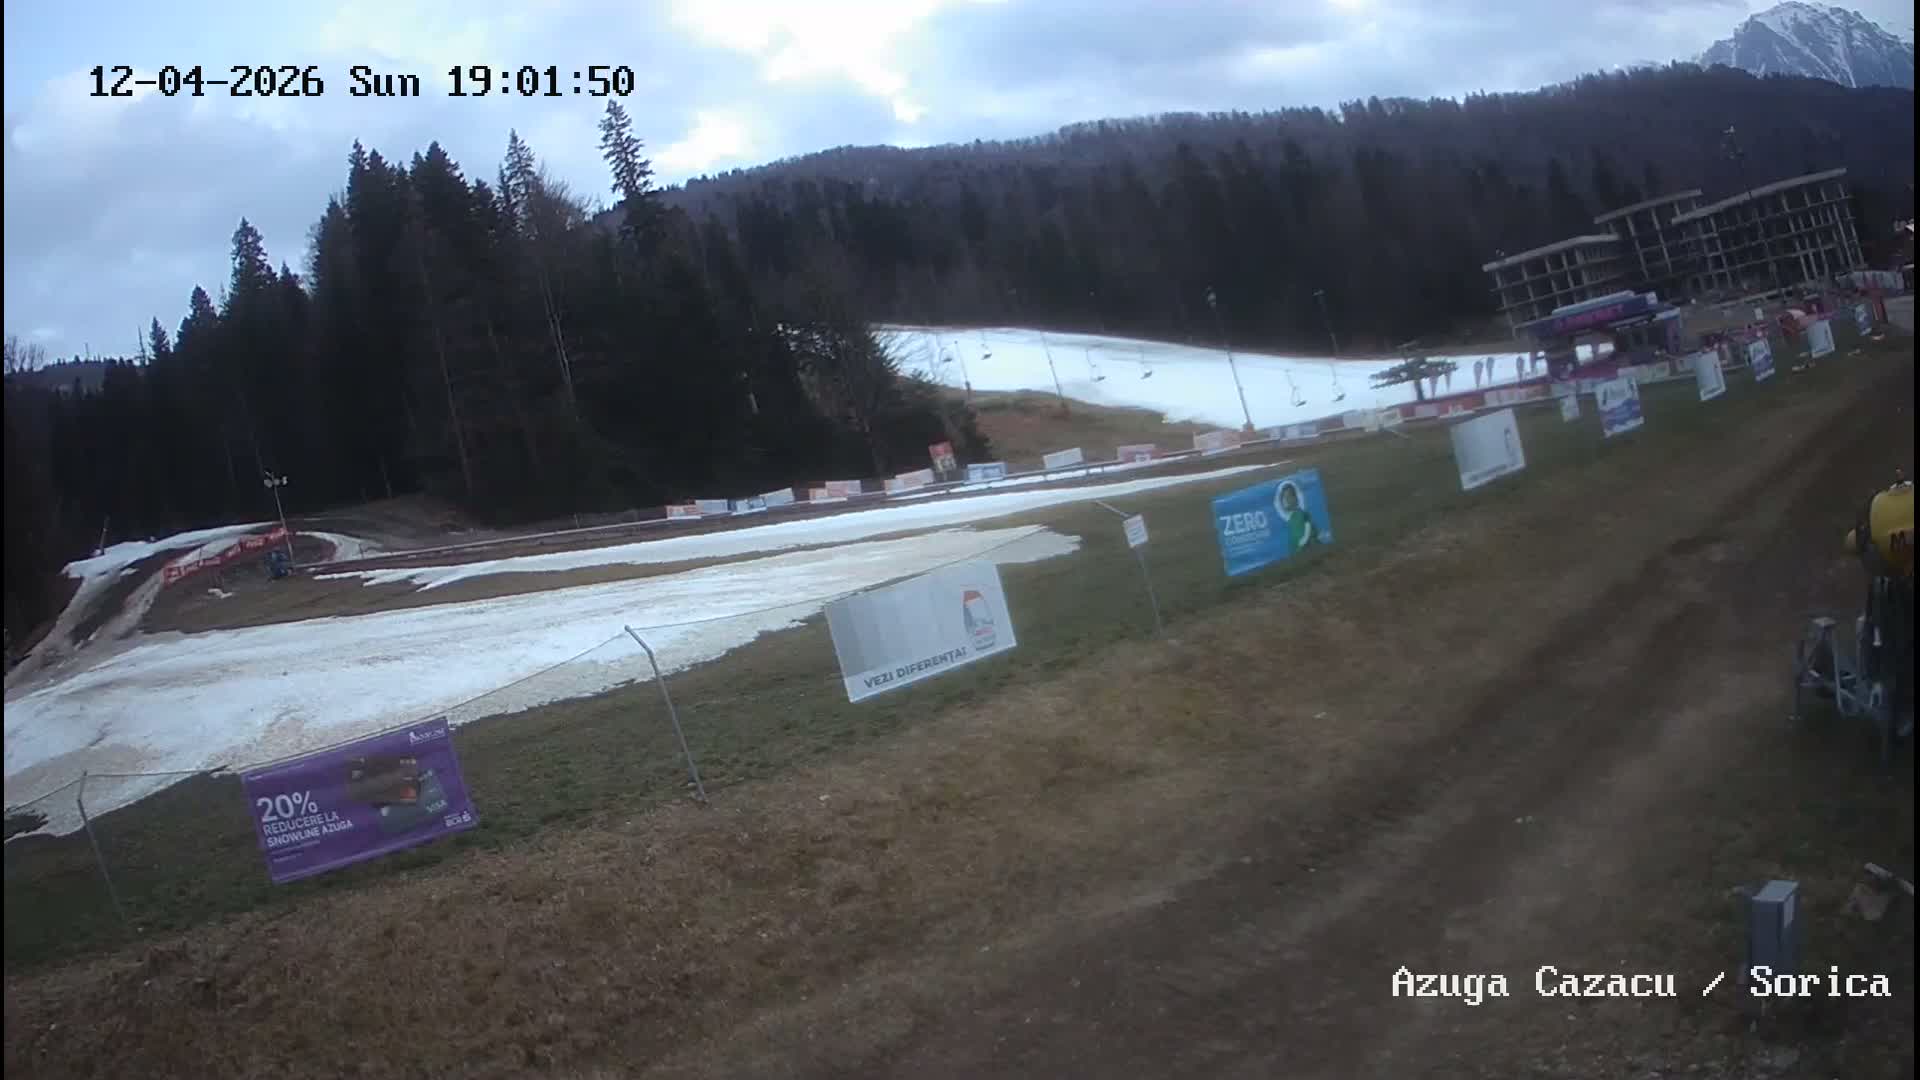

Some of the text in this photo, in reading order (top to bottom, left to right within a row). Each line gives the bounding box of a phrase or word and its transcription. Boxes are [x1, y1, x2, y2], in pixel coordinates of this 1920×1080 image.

[1220, 511, 1267, 536] ZERO
[864, 672, 894, 688] VEZI
[256, 790, 318, 822] 20%
[263, 811, 340, 836] REDUCERE LA
[267, 820, 353, 847] SNOWLINE AZUGA
